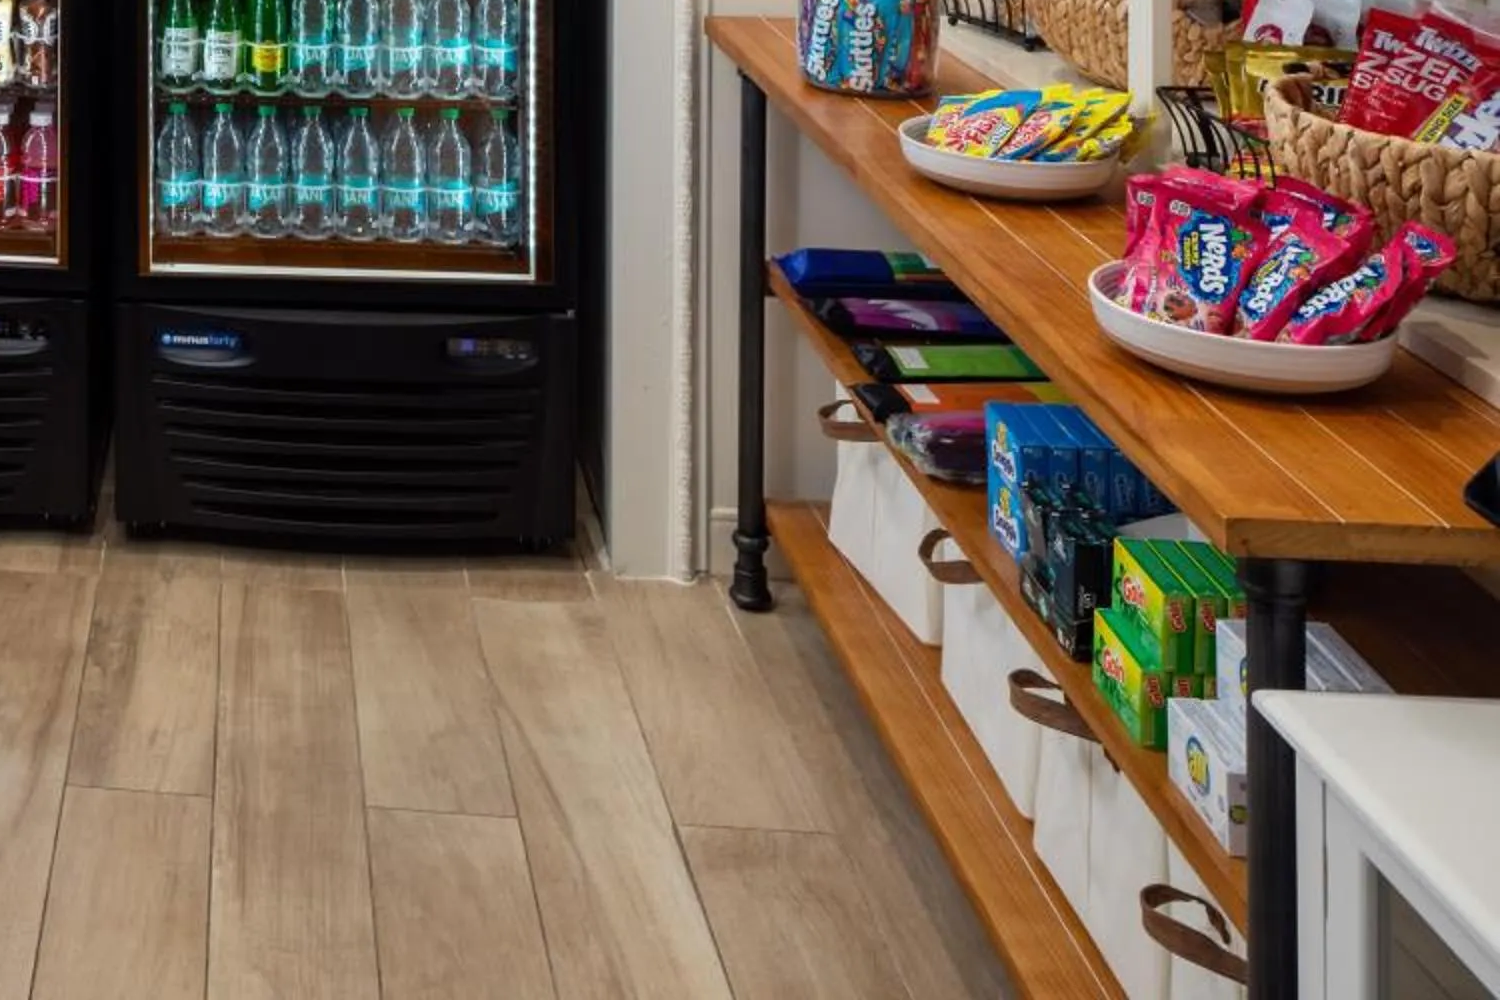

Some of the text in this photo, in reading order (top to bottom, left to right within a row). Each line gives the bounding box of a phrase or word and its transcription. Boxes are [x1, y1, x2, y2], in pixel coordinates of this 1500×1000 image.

[848, 2, 877, 93] Skittles
[1383, 66, 1447, 102] SUG
[1102, 646, 1125, 684] Gain
